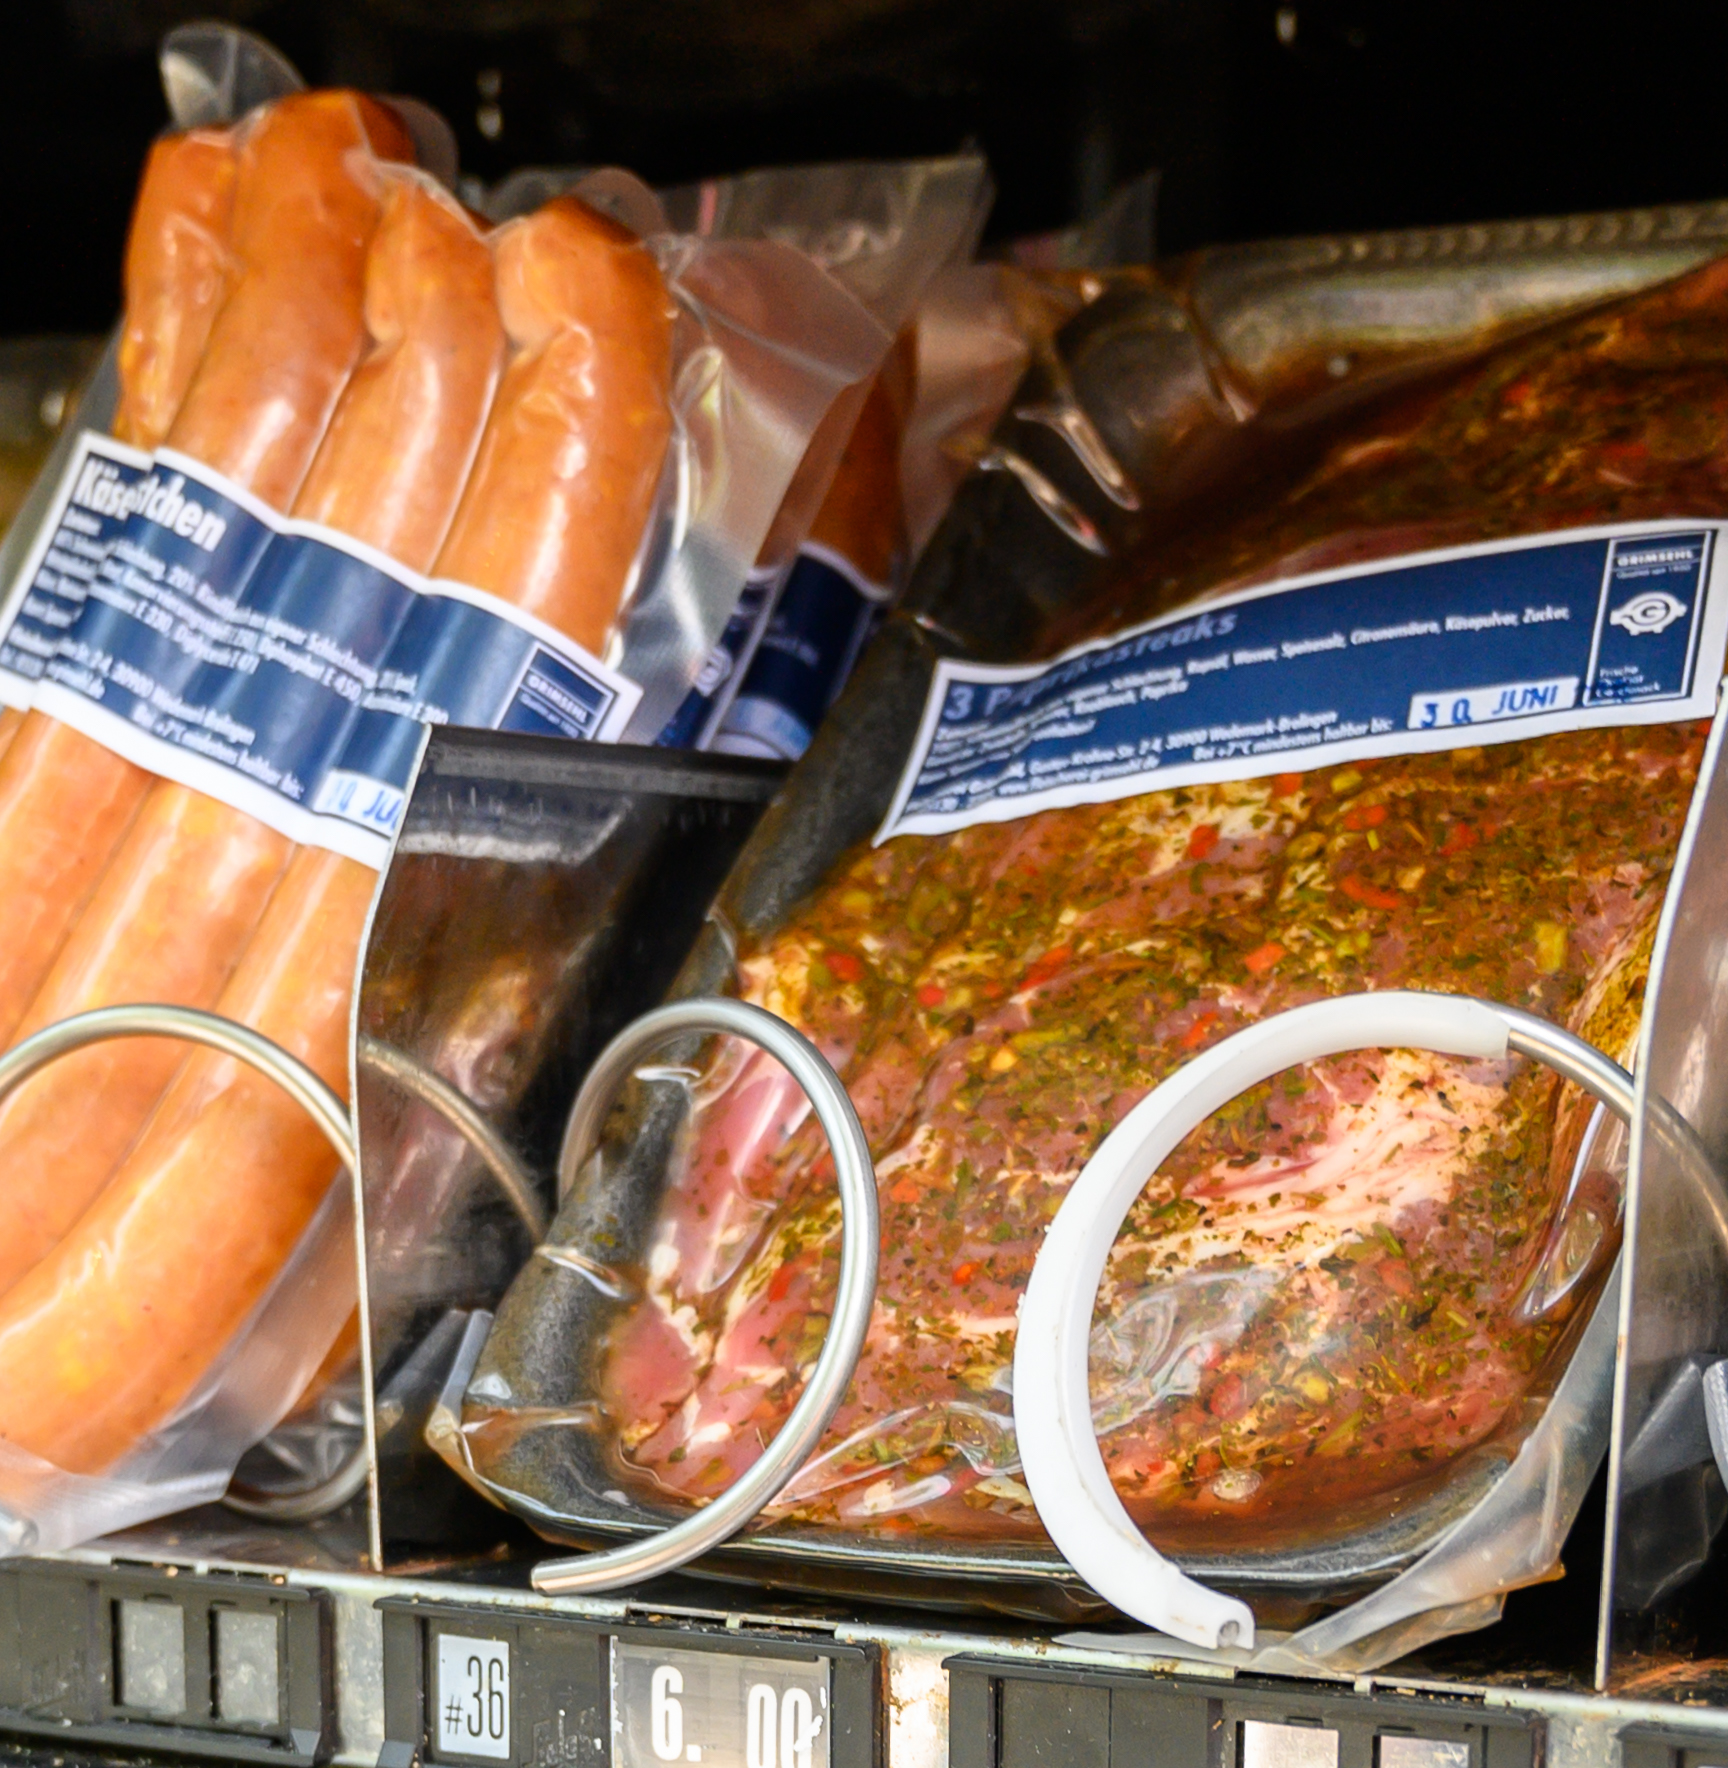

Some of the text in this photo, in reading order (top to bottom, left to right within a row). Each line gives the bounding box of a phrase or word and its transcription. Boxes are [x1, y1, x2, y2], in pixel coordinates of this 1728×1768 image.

[943, 686, 974, 720] 3
[1491, 684, 1560, 716] JUNI
[444, 1655, 505, 1740] #36
